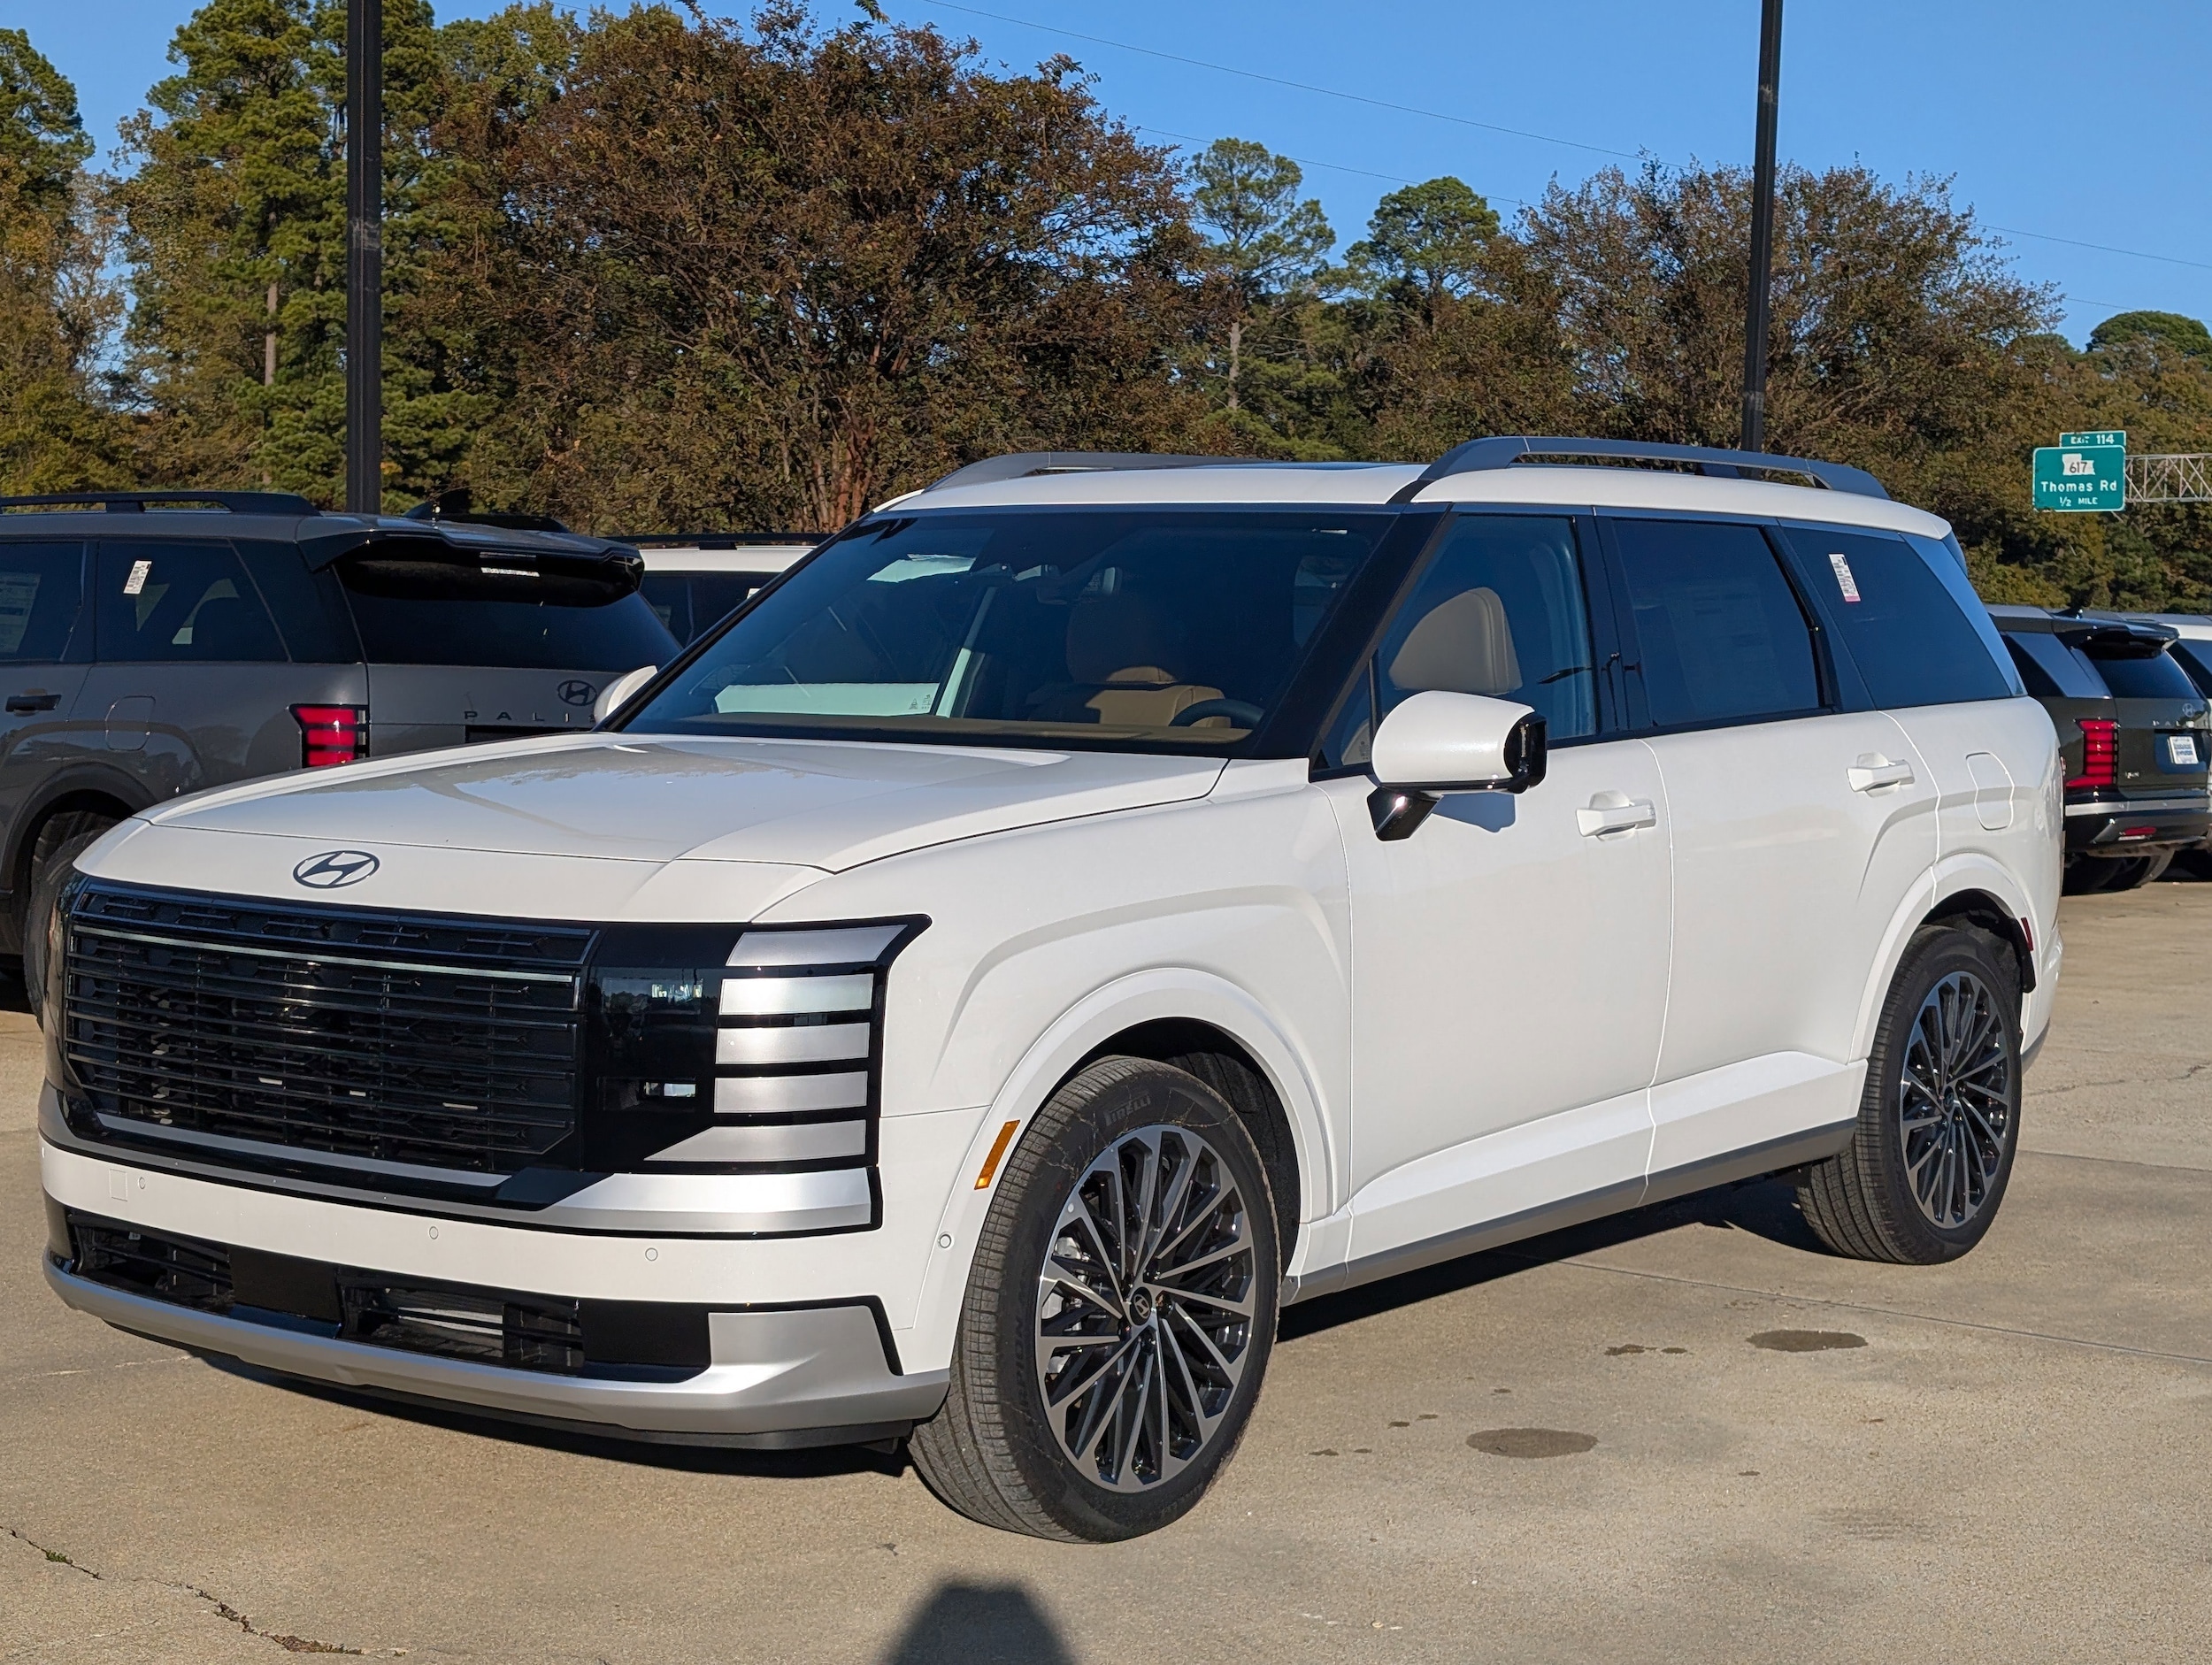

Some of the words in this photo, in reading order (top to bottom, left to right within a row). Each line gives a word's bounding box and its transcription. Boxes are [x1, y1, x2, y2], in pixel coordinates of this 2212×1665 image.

[2096, 434, 2115, 444] 114
[2069, 461, 2088, 473] 617
[2040, 480, 2093, 493] Thomas
[2100, 480, 2117, 491] Rd
[2078, 496, 2098, 505] MILE
[1103, 1091, 1151, 1125] PIRELLI
